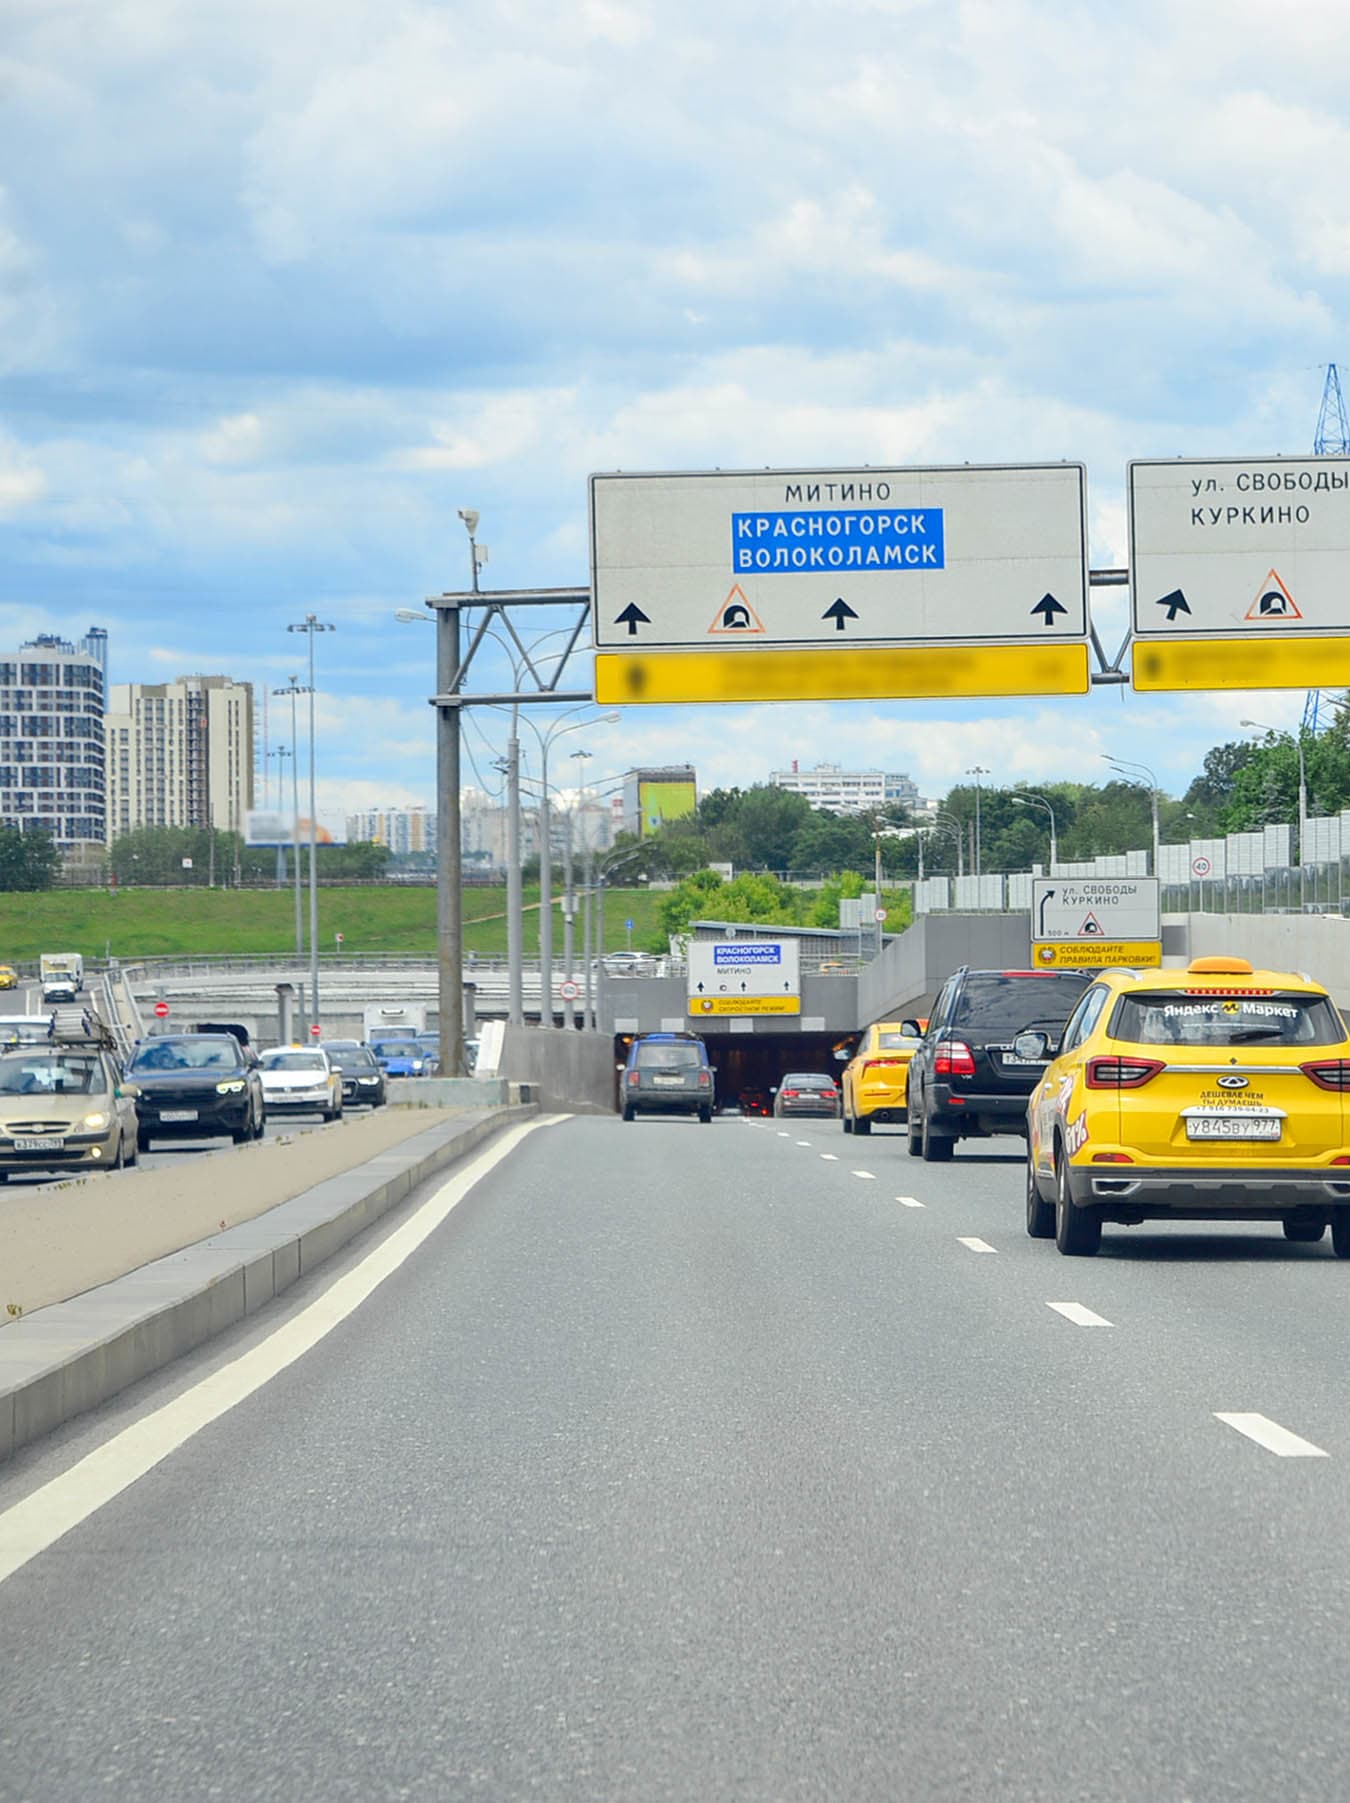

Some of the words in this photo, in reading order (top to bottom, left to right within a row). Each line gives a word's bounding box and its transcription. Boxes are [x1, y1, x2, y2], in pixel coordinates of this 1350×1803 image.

[1191, 478, 1225, 496] ул.
[1236, 471, 1350, 492] СВОБОДЫ
[785, 482, 891, 504] МИТИНО
[1191, 505, 1311, 526] КУРКИНО
[738, 513, 927, 538] КРАСНОГОРСК
[739, 543, 938, 568] ВОЛОКОЛАМСК
[1062, 887, 1078, 895] ул.
[1083, 884, 1137, 895] СВОБОДЫ
[1062, 896, 1119, 905] КУРКИНО
[716, 947, 776, 955] КРАСНОГОРСК
[1060, 945, 1124, 955] СОБЛЮДАЙТЕ
[716, 955, 779, 963] ВОЛОКОЛАМСК
[1059, 956, 1102, 964] ПРАВИЛА
[717, 967, 752, 975] МИТИНО
[1164, 1003, 1219, 1017] Яндекс
[1243, 1004, 1298, 1018] Маркет
[1244, 1092, 1264, 1100] ЧЕМ
[1217, 1099, 1262, 1107] ДУМАЕШЬ
